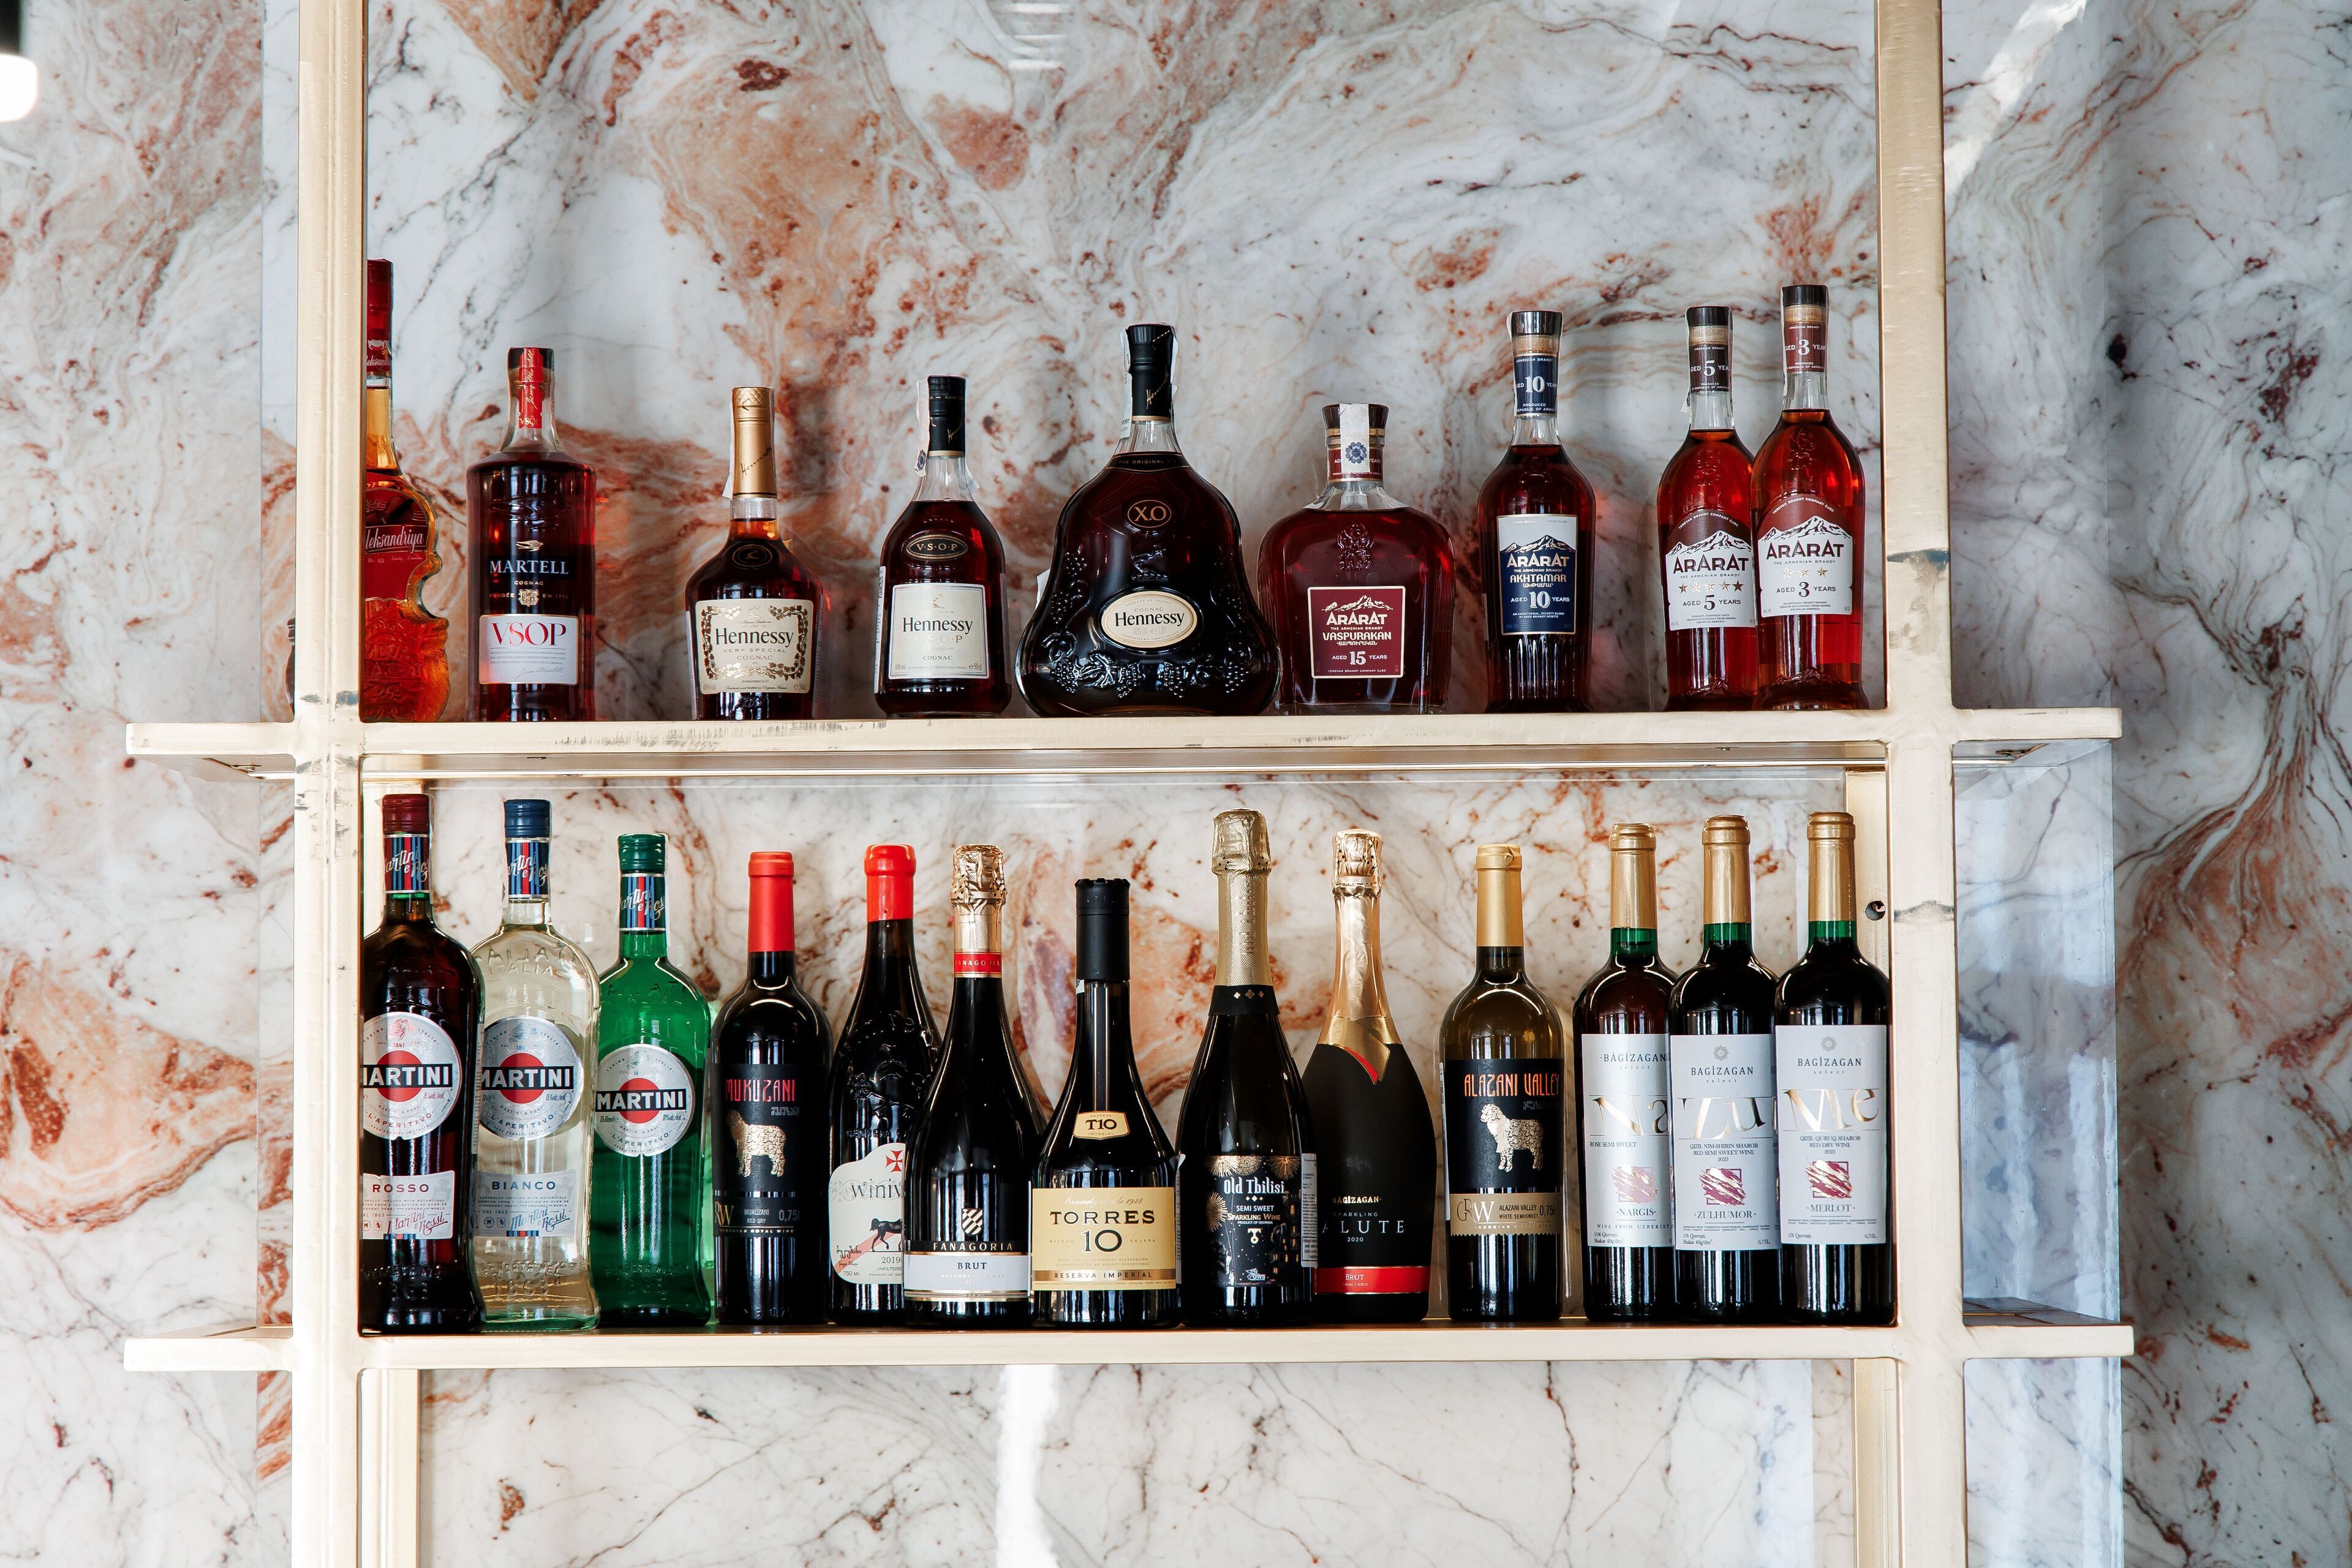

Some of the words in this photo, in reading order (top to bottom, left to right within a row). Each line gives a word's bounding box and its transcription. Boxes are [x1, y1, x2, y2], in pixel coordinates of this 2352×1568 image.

[1704, 360, 1715, 376] 5
[1773, 502, 1787, 514] YEREVAN
[1805, 497, 1825, 506] COMPANY
[1678, 518, 1692, 529] YEREVAN
[1729, 518, 1739, 527] CJSC
[366, 526, 423, 554] leksandriya
[1766, 539, 1844, 560] ARARAT
[490, 560, 568, 574] MARTELL
[1507, 552, 1570, 567] ARARAT
[1673, 554, 1749, 574] ARARAT
[1510, 574, 1566, 582] AKHTAMAR
[1798, 581, 1810, 597] 3
[1529, 591, 1551, 609] 10
[1703, 594, 1715, 611] 5
[903, 617, 973, 635] Hennessy
[1115, 612, 1185, 627] Hennessy
[1326, 611, 1388, 625] ARARAT
[491, 622, 567, 646] VSOP
[715, 628, 794, 647] Hennessy
[1323, 631, 1392, 640] VASPURAKAN
[1349, 651, 1366, 665] 15
[385, 846, 418, 873] artini
[621, 886, 652, 911] artini
[363, 1066, 449, 1086] ARTINI
[726, 1079, 796, 1102] MUKUZANI
[1464, 1074, 1518, 1097] ALAZANI
[1524, 1073, 1560, 1096] VALLEY
[597, 1091, 684, 1110] MARTINI
[1085, 1118, 1118, 1131] T10
[372, 1183, 429, 1193] ROSSO
[492, 1181, 556, 1190] BIANCO
[1224, 1177, 1243, 1194] Old
[1246, 1177, 1285, 1194] Tbilisi
[1063, 1196, 1098, 1208] Brandy
[1126, 1198, 1144, 1207] 1928
[1050, 1210, 1155, 1225] TORRES
[1322, 1220, 1405, 1234] ALUTE
[933, 1242, 1012, 1251] FANAGORIA
[1080, 1229, 1123, 1252] 10
